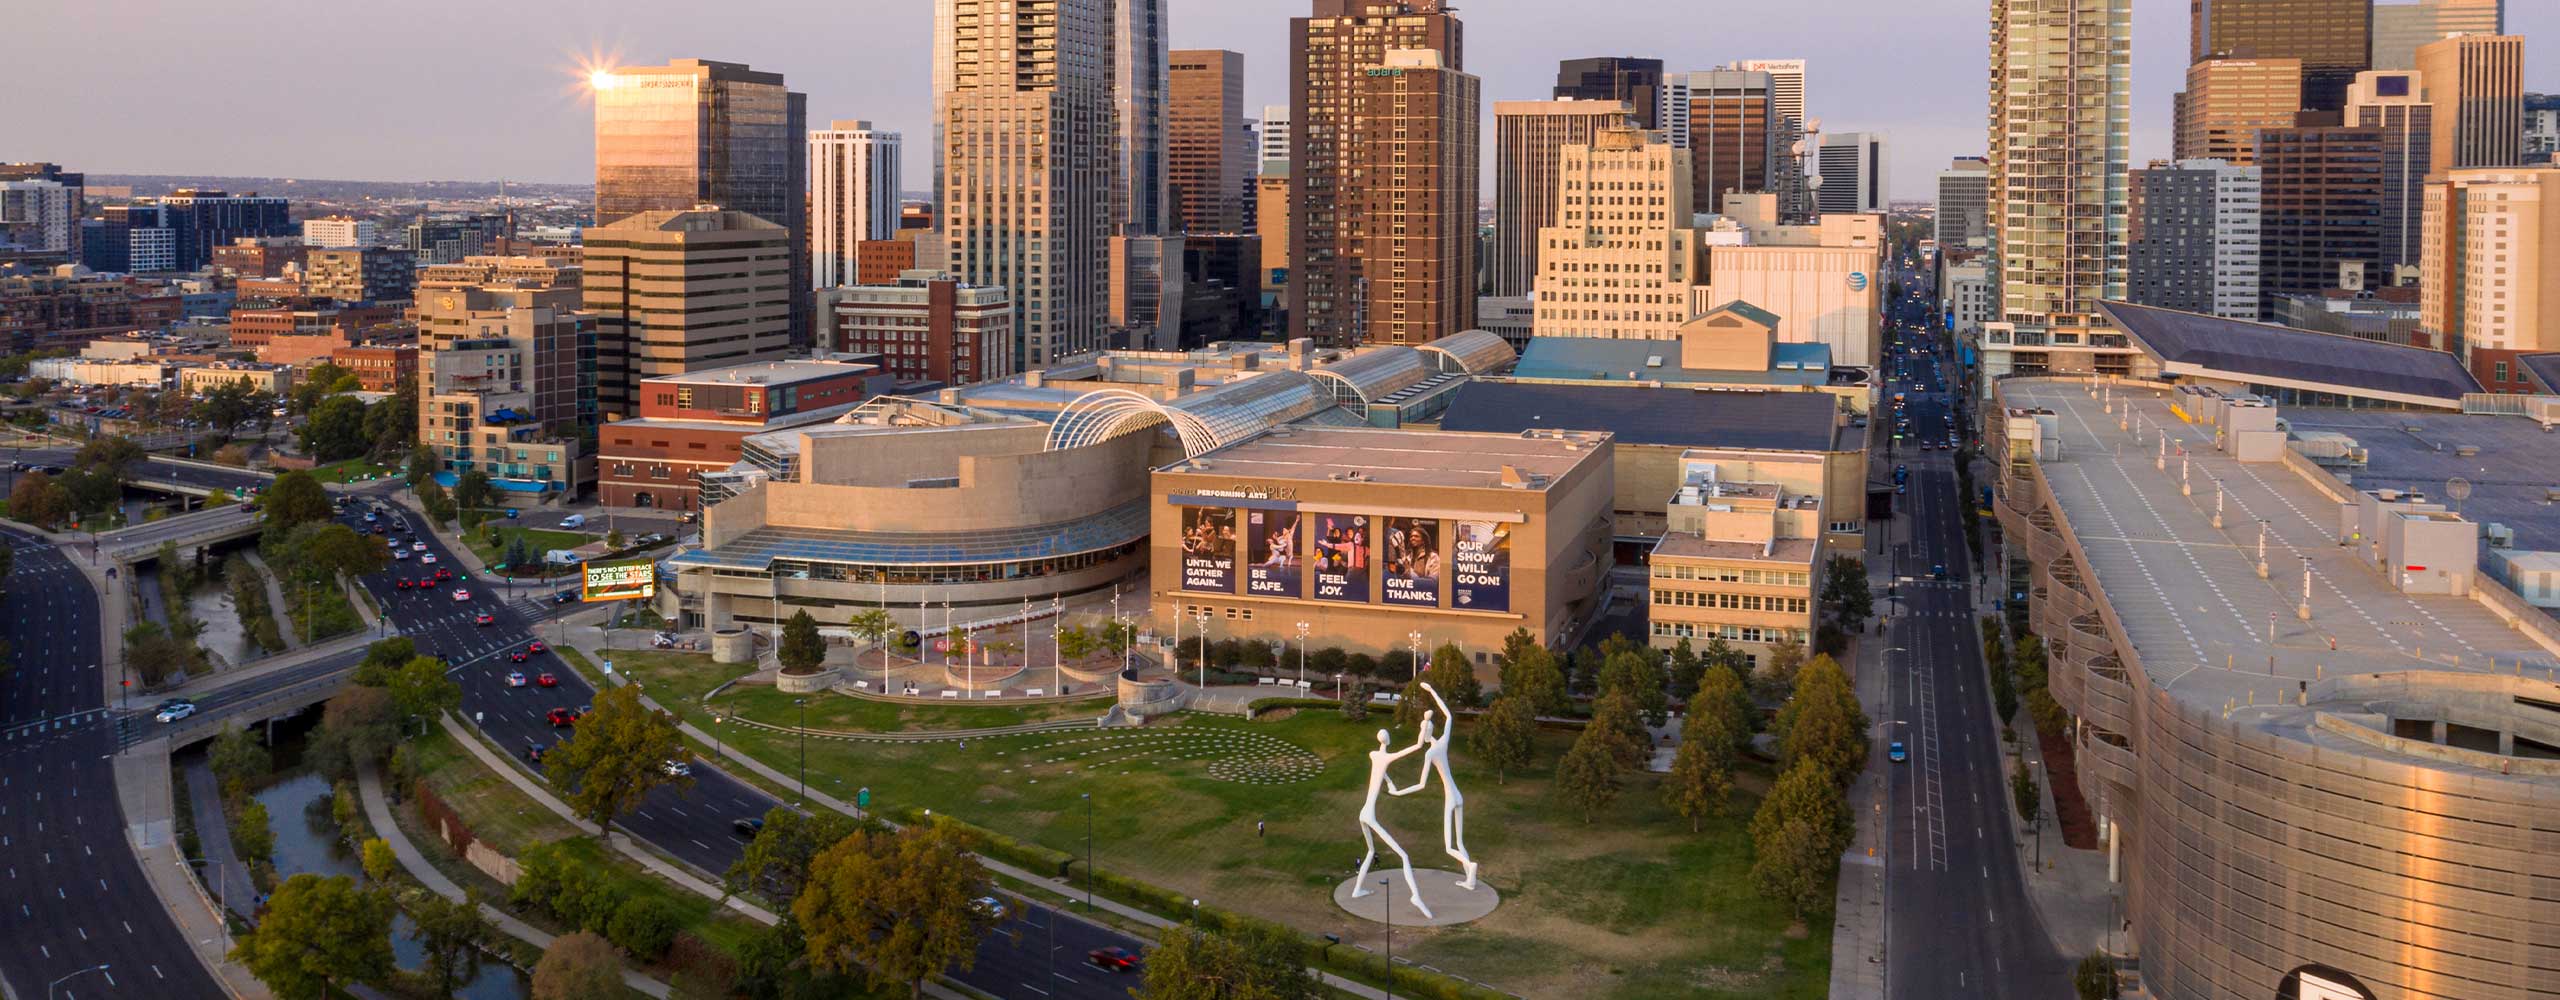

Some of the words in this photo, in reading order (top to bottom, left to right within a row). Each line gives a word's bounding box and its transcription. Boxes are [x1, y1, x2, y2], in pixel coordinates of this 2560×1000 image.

[1197, 489, 1246, 498] PERFORMING
[1232, 483, 1297, 500] COMPLEX
[1248, 491, 1268, 500] ARTS
[1457, 541, 1483, 551] OUR
[1457, 552, 1494, 563] SHOW
[1186, 559, 1213, 568] UNTIL
[1215, 560, 1231, 569] WE
[1457, 563, 1488, 574] WILL
[600, 572, 614, 580] SEE
[615, 572, 628, 580] THE
[1186, 568, 1223, 578] GATHER
[1251, 569, 1267, 579] BE
[1186, 578, 1223, 587] AGAIN...
[1319, 574, 1347, 584] FEEL
[1386, 578, 1413, 588] GIVE
[1457, 574, 1475, 584] GO
[1478, 575, 1500, 586] ON!
[1251, 581, 1284, 591] SAFE.
[1319, 586, 1342, 595] JOY.
[1386, 589, 1436, 601] THANKS.
